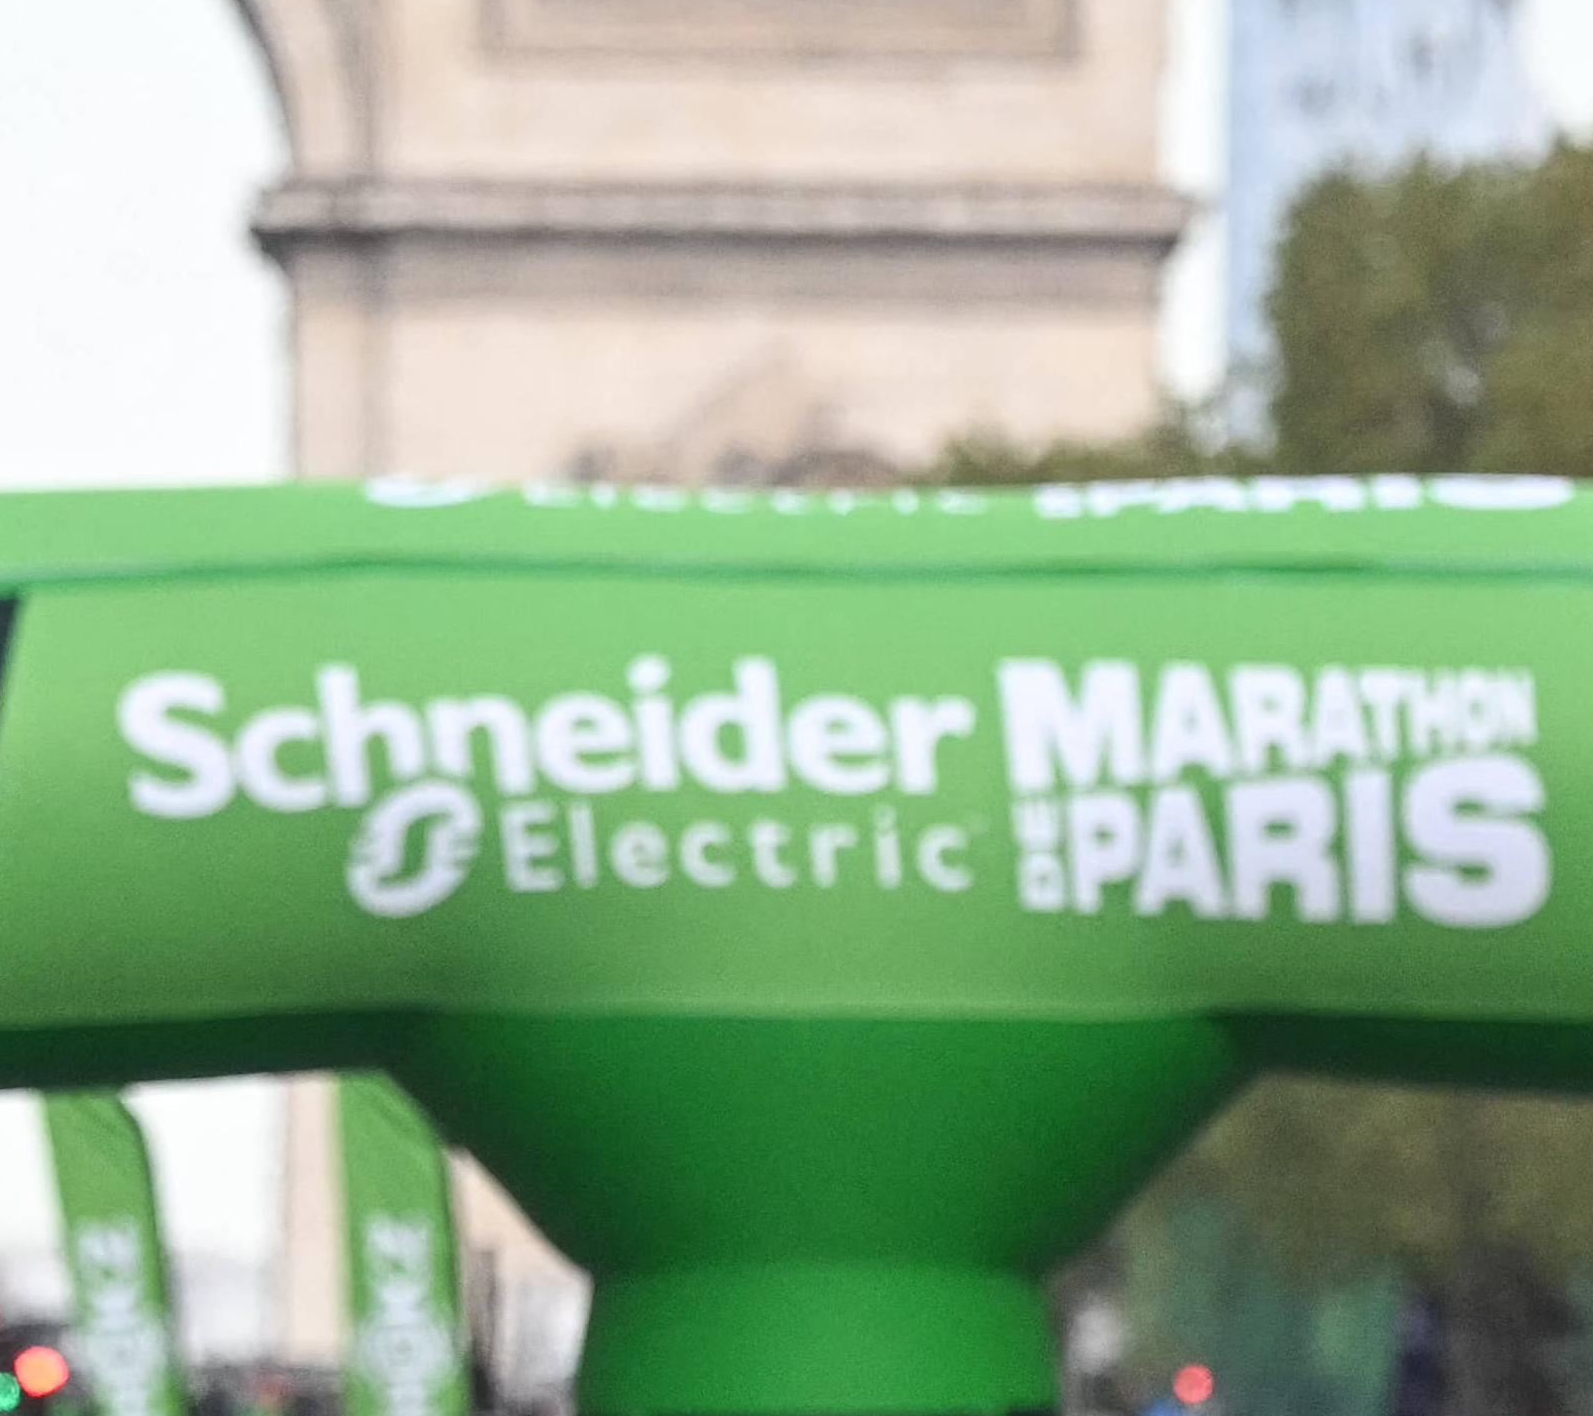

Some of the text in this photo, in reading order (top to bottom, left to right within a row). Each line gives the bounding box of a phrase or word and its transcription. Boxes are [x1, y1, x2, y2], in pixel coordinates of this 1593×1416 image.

[116, 654, 976, 820] Schneider
[997, 657, 1540, 786] MARATHON
[497, 796, 974, 892] Electric
[1069, 752, 1551, 928] PARIS
